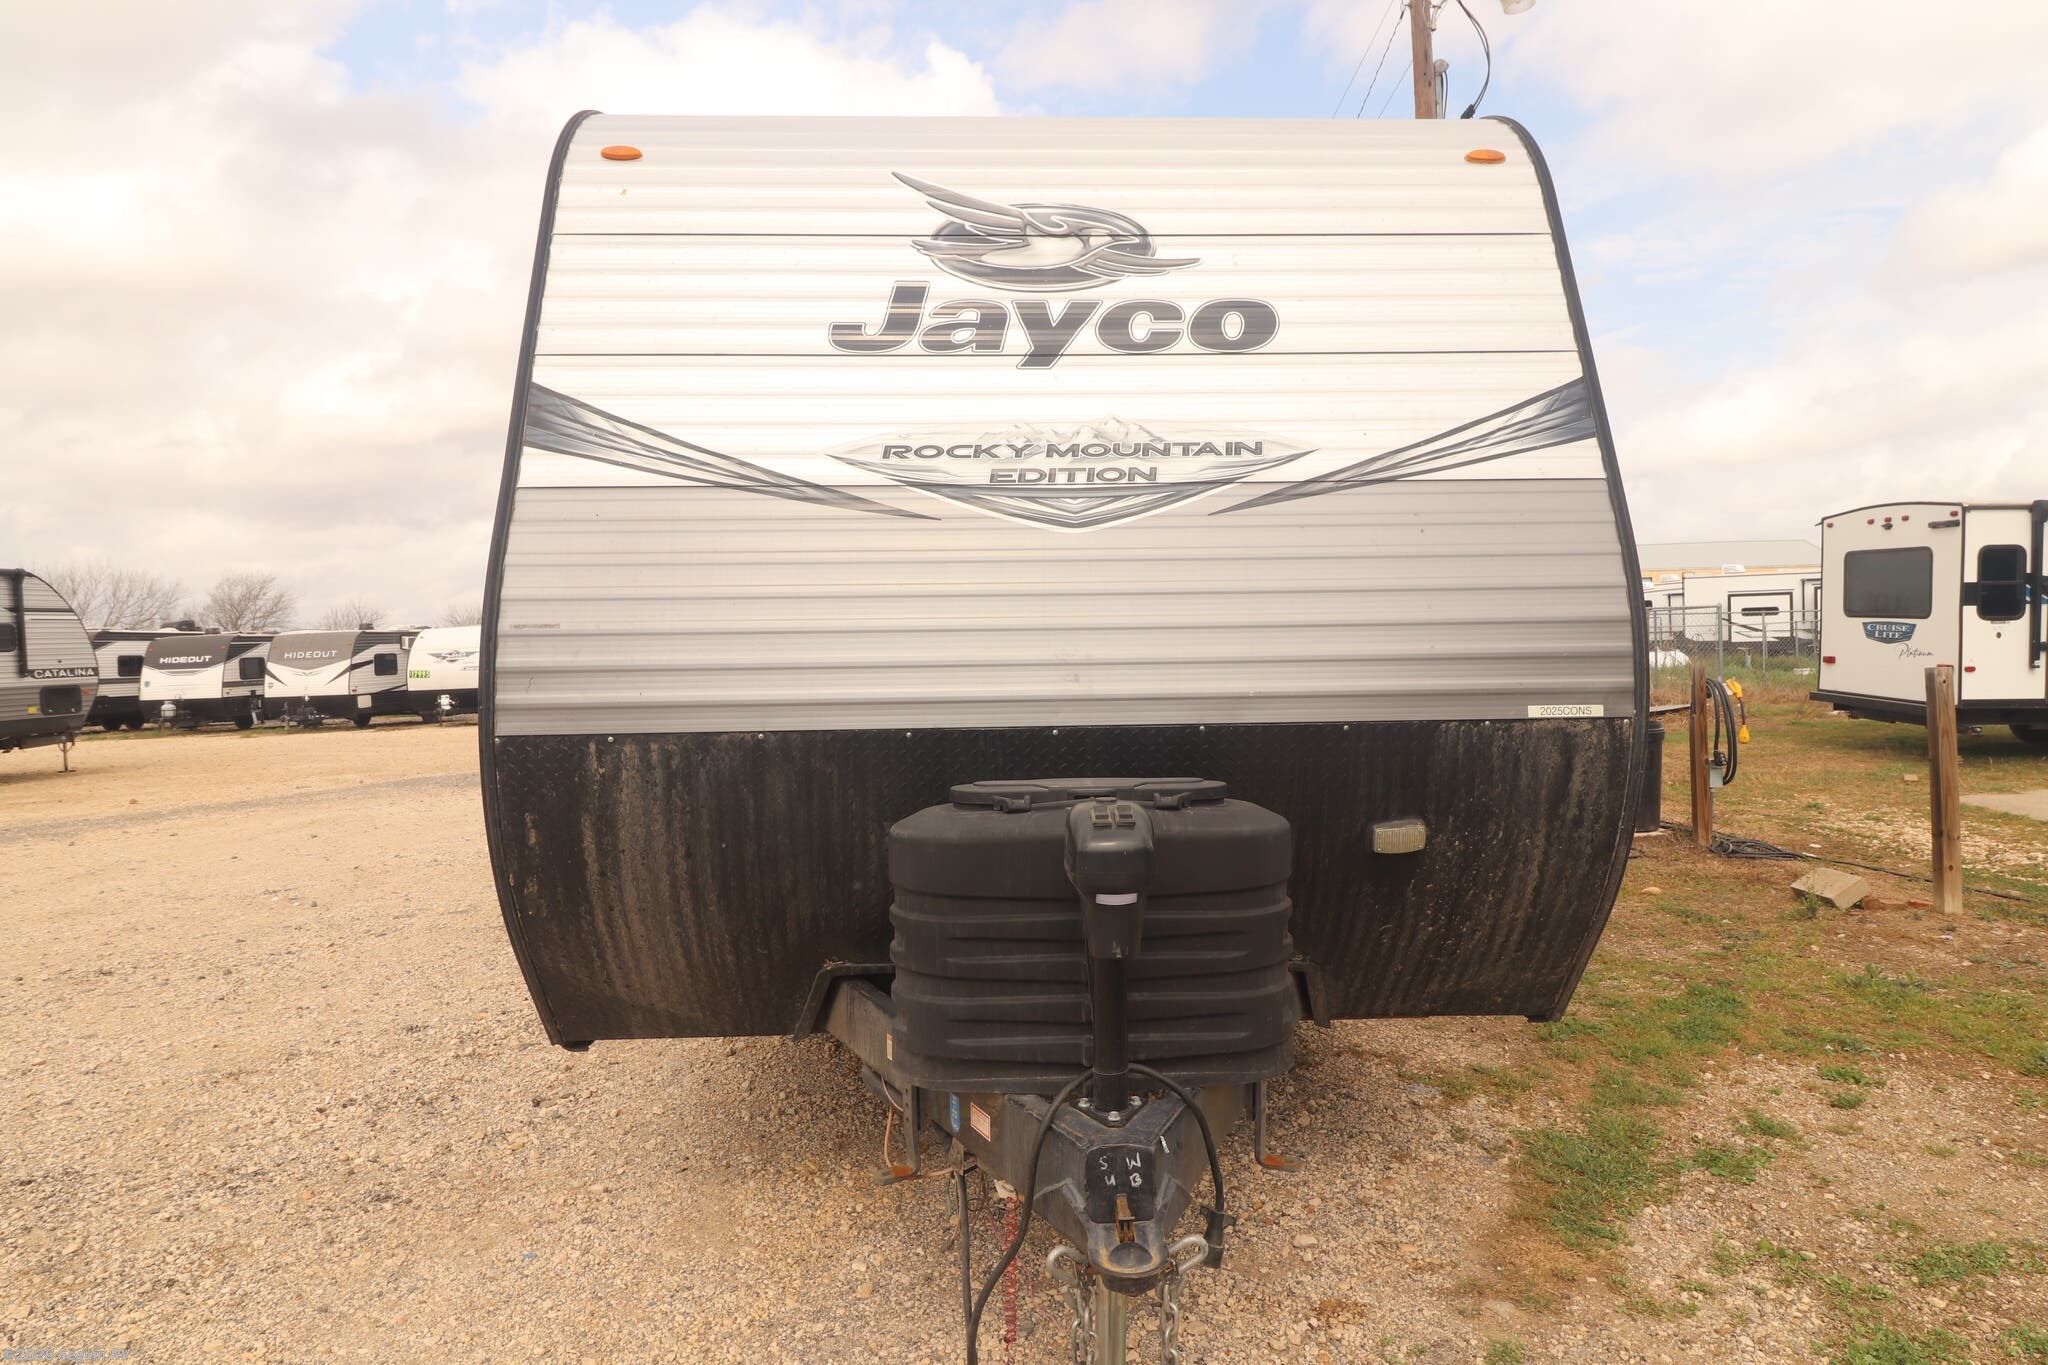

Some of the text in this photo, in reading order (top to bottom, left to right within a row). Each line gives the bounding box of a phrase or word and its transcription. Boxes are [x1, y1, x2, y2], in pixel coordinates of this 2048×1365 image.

[828, 280, 1280, 369] Jayco
[882, 440, 1264, 460] ROCKY MOUNTAIN
[989, 467, 1158, 485] EDITION
[1867, 623, 1910, 632] CRUISE
[1875, 631, 1903, 639] LITE
[284, 650, 337, 659] HIDEOUT
[1898, 643, 1933, 659] Platinum
[159, 655, 212, 664] HIDEOUT
[34, 668, 95, 678] CATALINA
[1540, 706, 1592, 716] 2025CONS
